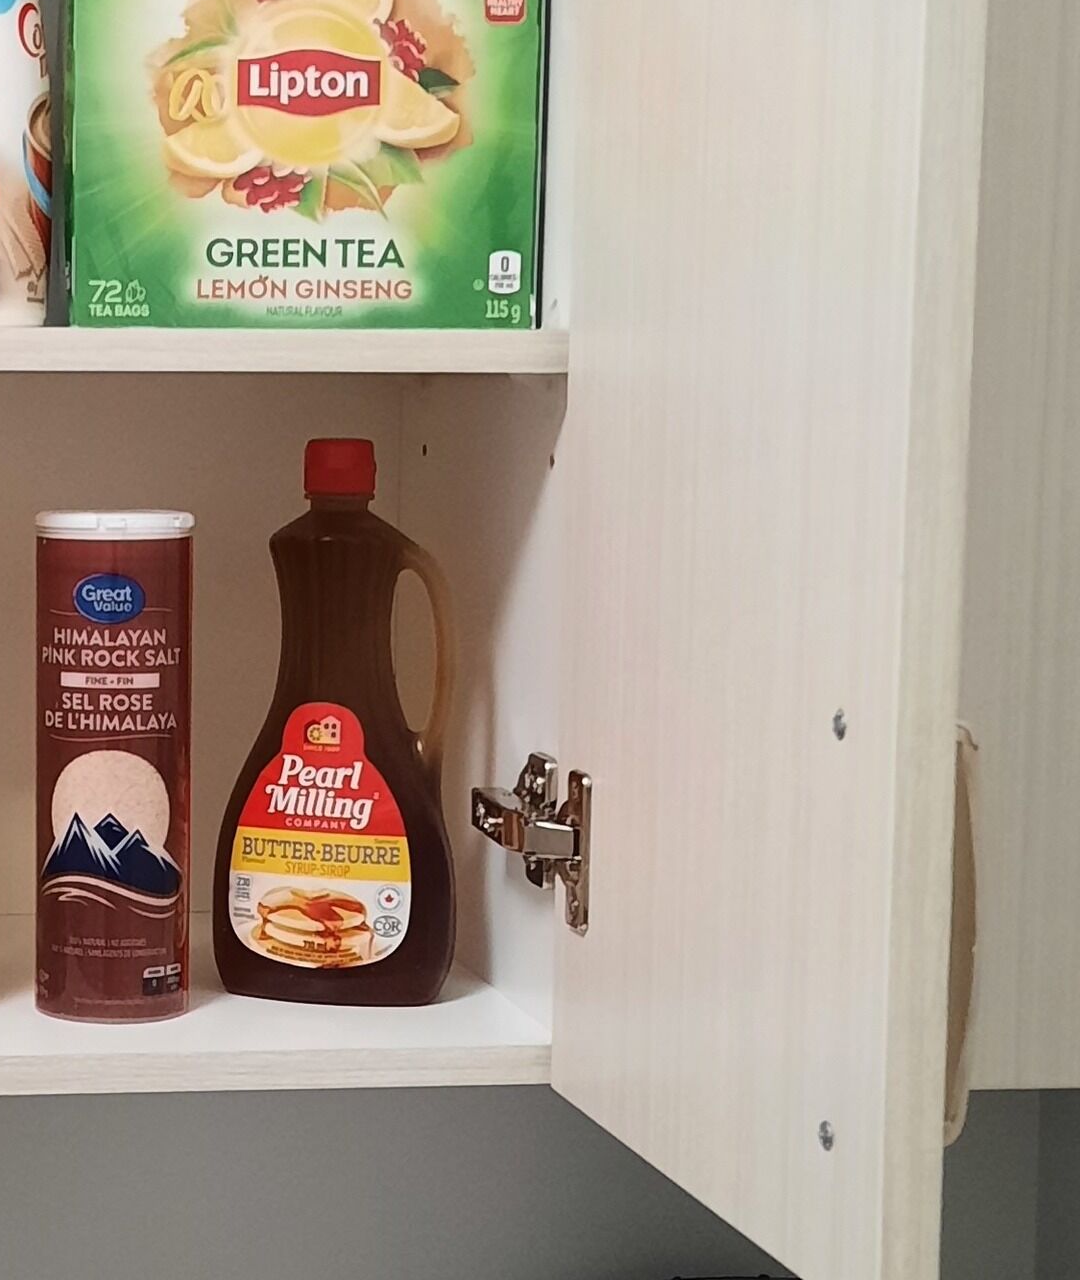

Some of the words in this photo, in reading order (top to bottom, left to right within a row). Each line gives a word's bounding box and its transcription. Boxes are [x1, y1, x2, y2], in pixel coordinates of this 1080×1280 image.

[249, 62, 369, 104] Lipton
[205, 238, 328, 269] GREEN
[334, 238, 405, 269] TEA
[500, 256, 510, 273] 0
[88, 279, 123, 304] 72
[196, 276, 287, 300] LEMON
[295, 278, 413, 300] GINSENG
[88, 304, 112, 317] TEA
[114, 305, 150, 318] BAGS
[485, 299, 509, 319] 115
[510, 304, 521, 324] g
[81, 584, 132, 602] Great
[93, 601, 133, 613] Value
[54, 627, 167, 647] HIMALAYAN
[42, 646, 76, 666] PINK
[81, 649, 141, 667] ROCK
[145, 648, 182, 666] SALT
[85, 676, 108, 686] FINE
[117, 676, 134, 686] FIN
[62, 692, 94, 710] SEL
[99, 693, 154, 712] ROSE
[45, 710, 64, 729] DE
[67, 712, 178, 732] L'HIMALAYA
[277, 754, 363, 790] Pearl
[265, 784, 374, 830] Milling
[285, 817, 347, 830] COMPANY
[242, 837, 318, 861] BUTTER
[320, 843, 401, 866] BEURRE
[285, 861, 318, 875] SYRUP
[320, 865, 351, 878] SIROP
